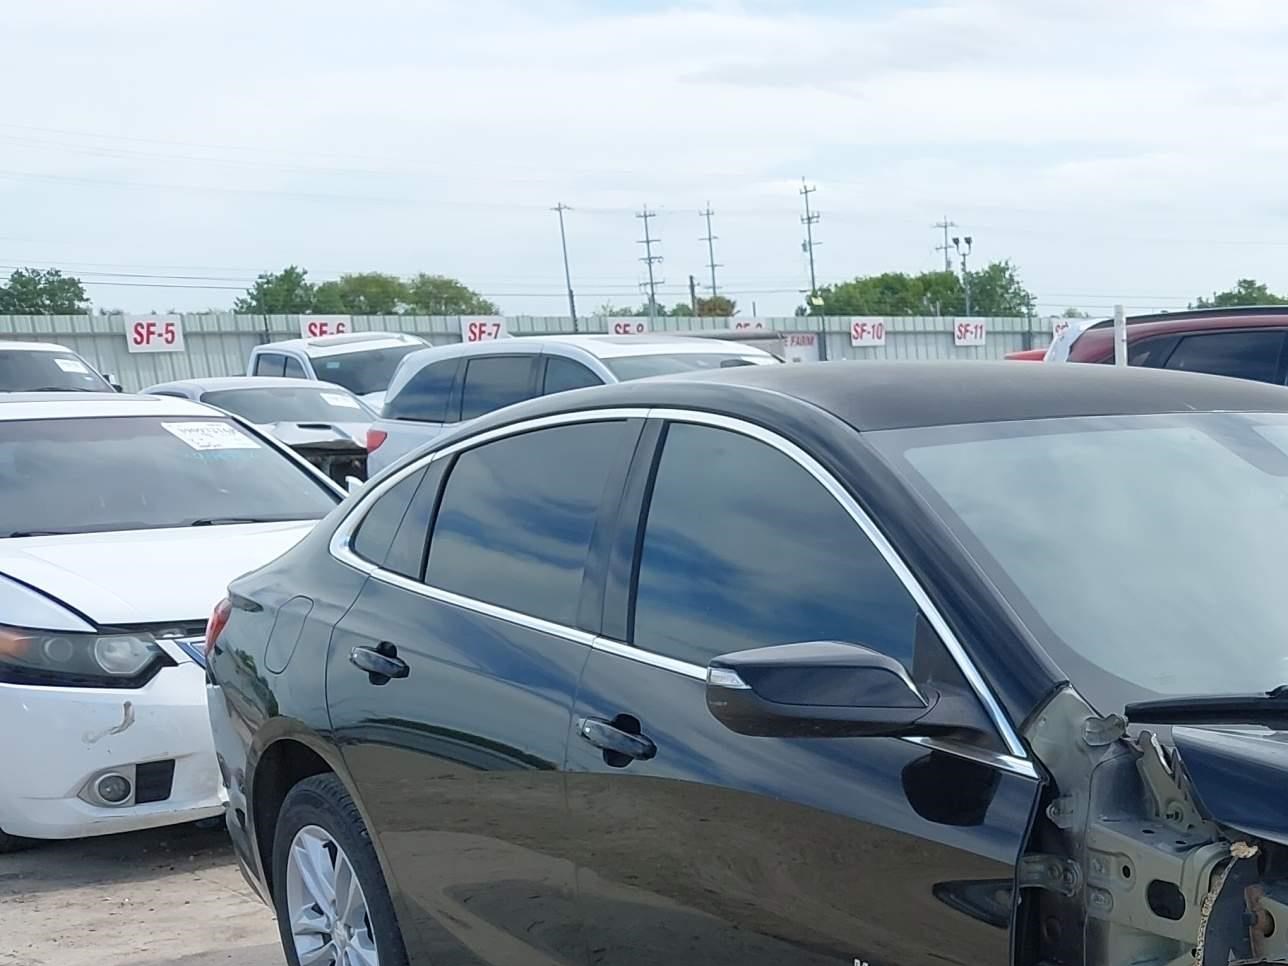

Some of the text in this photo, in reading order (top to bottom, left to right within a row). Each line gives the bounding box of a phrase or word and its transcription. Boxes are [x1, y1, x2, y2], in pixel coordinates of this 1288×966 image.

[132, 322, 176, 345] SF-5
[468, 322, 501, 342] SF-7
[852, 322, 884, 341] SF-10
[956, 322, 984, 340] SF-11
